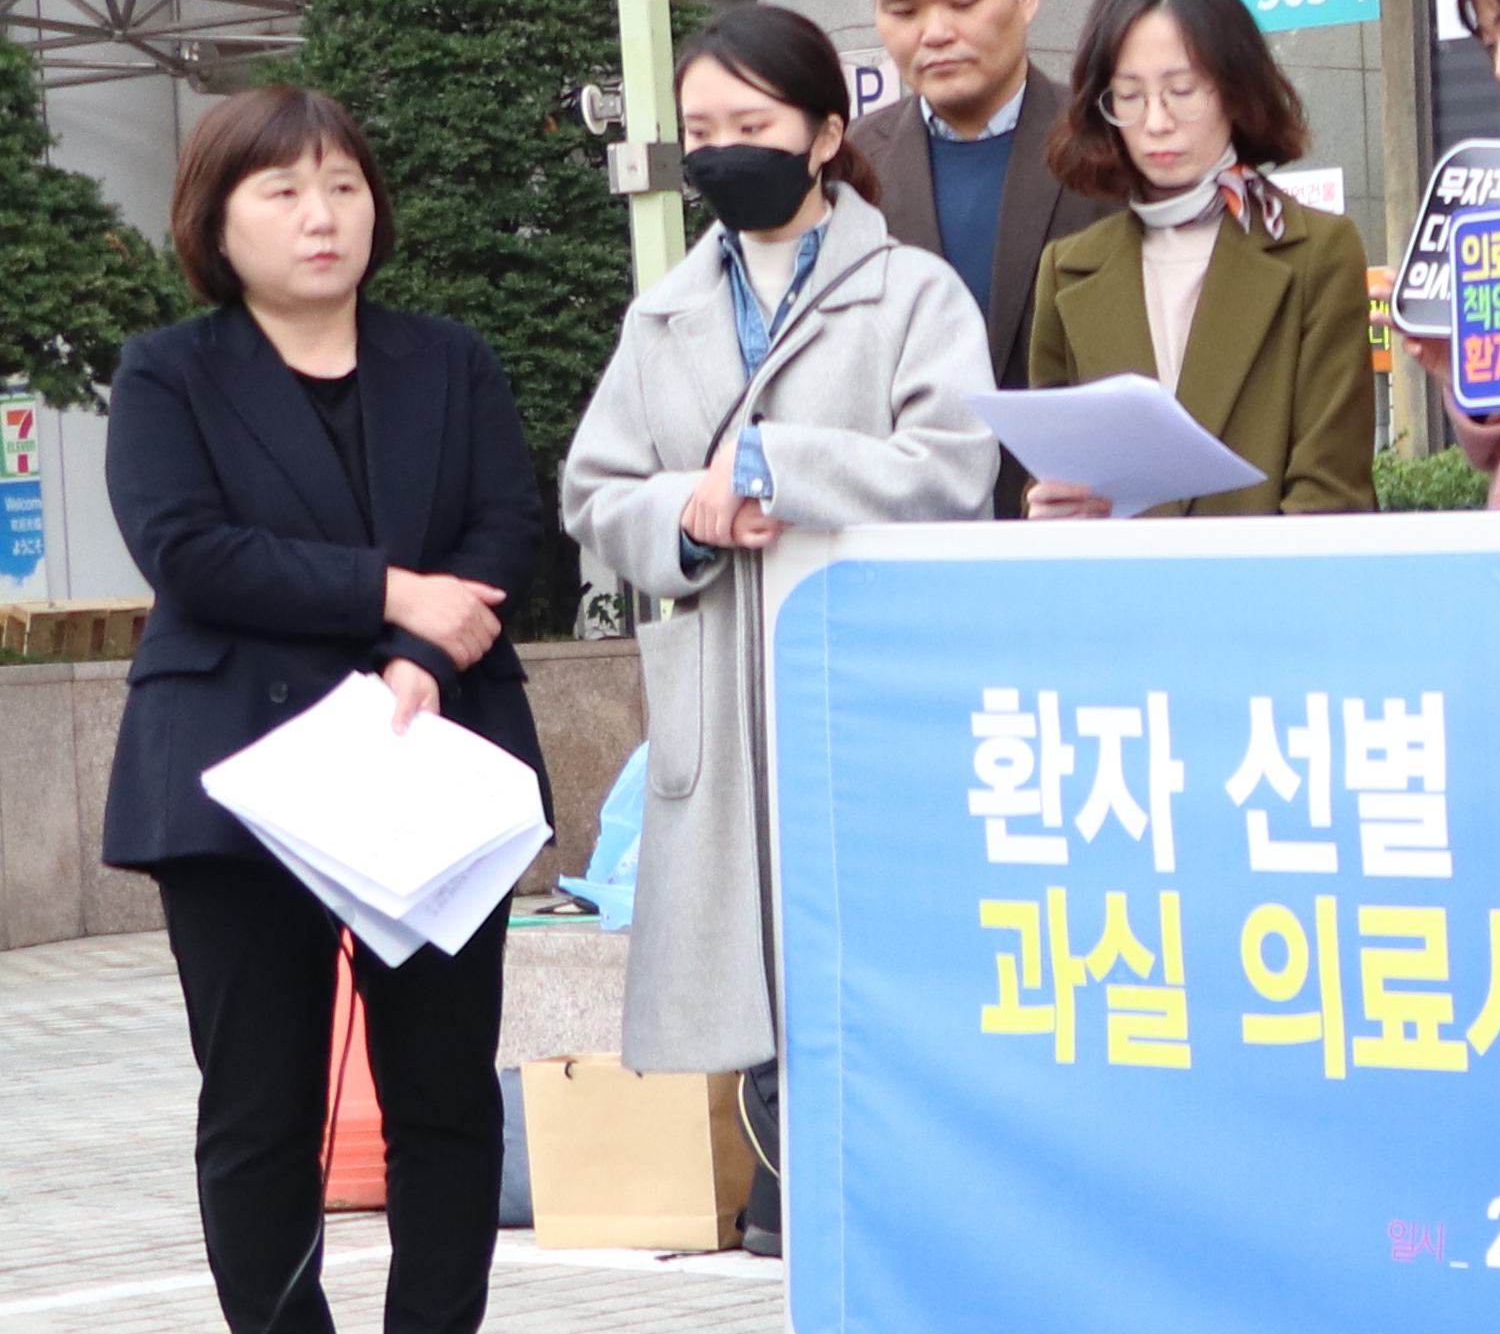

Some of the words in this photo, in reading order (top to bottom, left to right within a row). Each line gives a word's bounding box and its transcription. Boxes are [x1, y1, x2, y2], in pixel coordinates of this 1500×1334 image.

[4, 496, 42, 512] Welcom
[968, 687, 1184, 872] 환자
[1225, 691, 1452, 878] 선별
[980, 886, 1191, 1069] 과실
